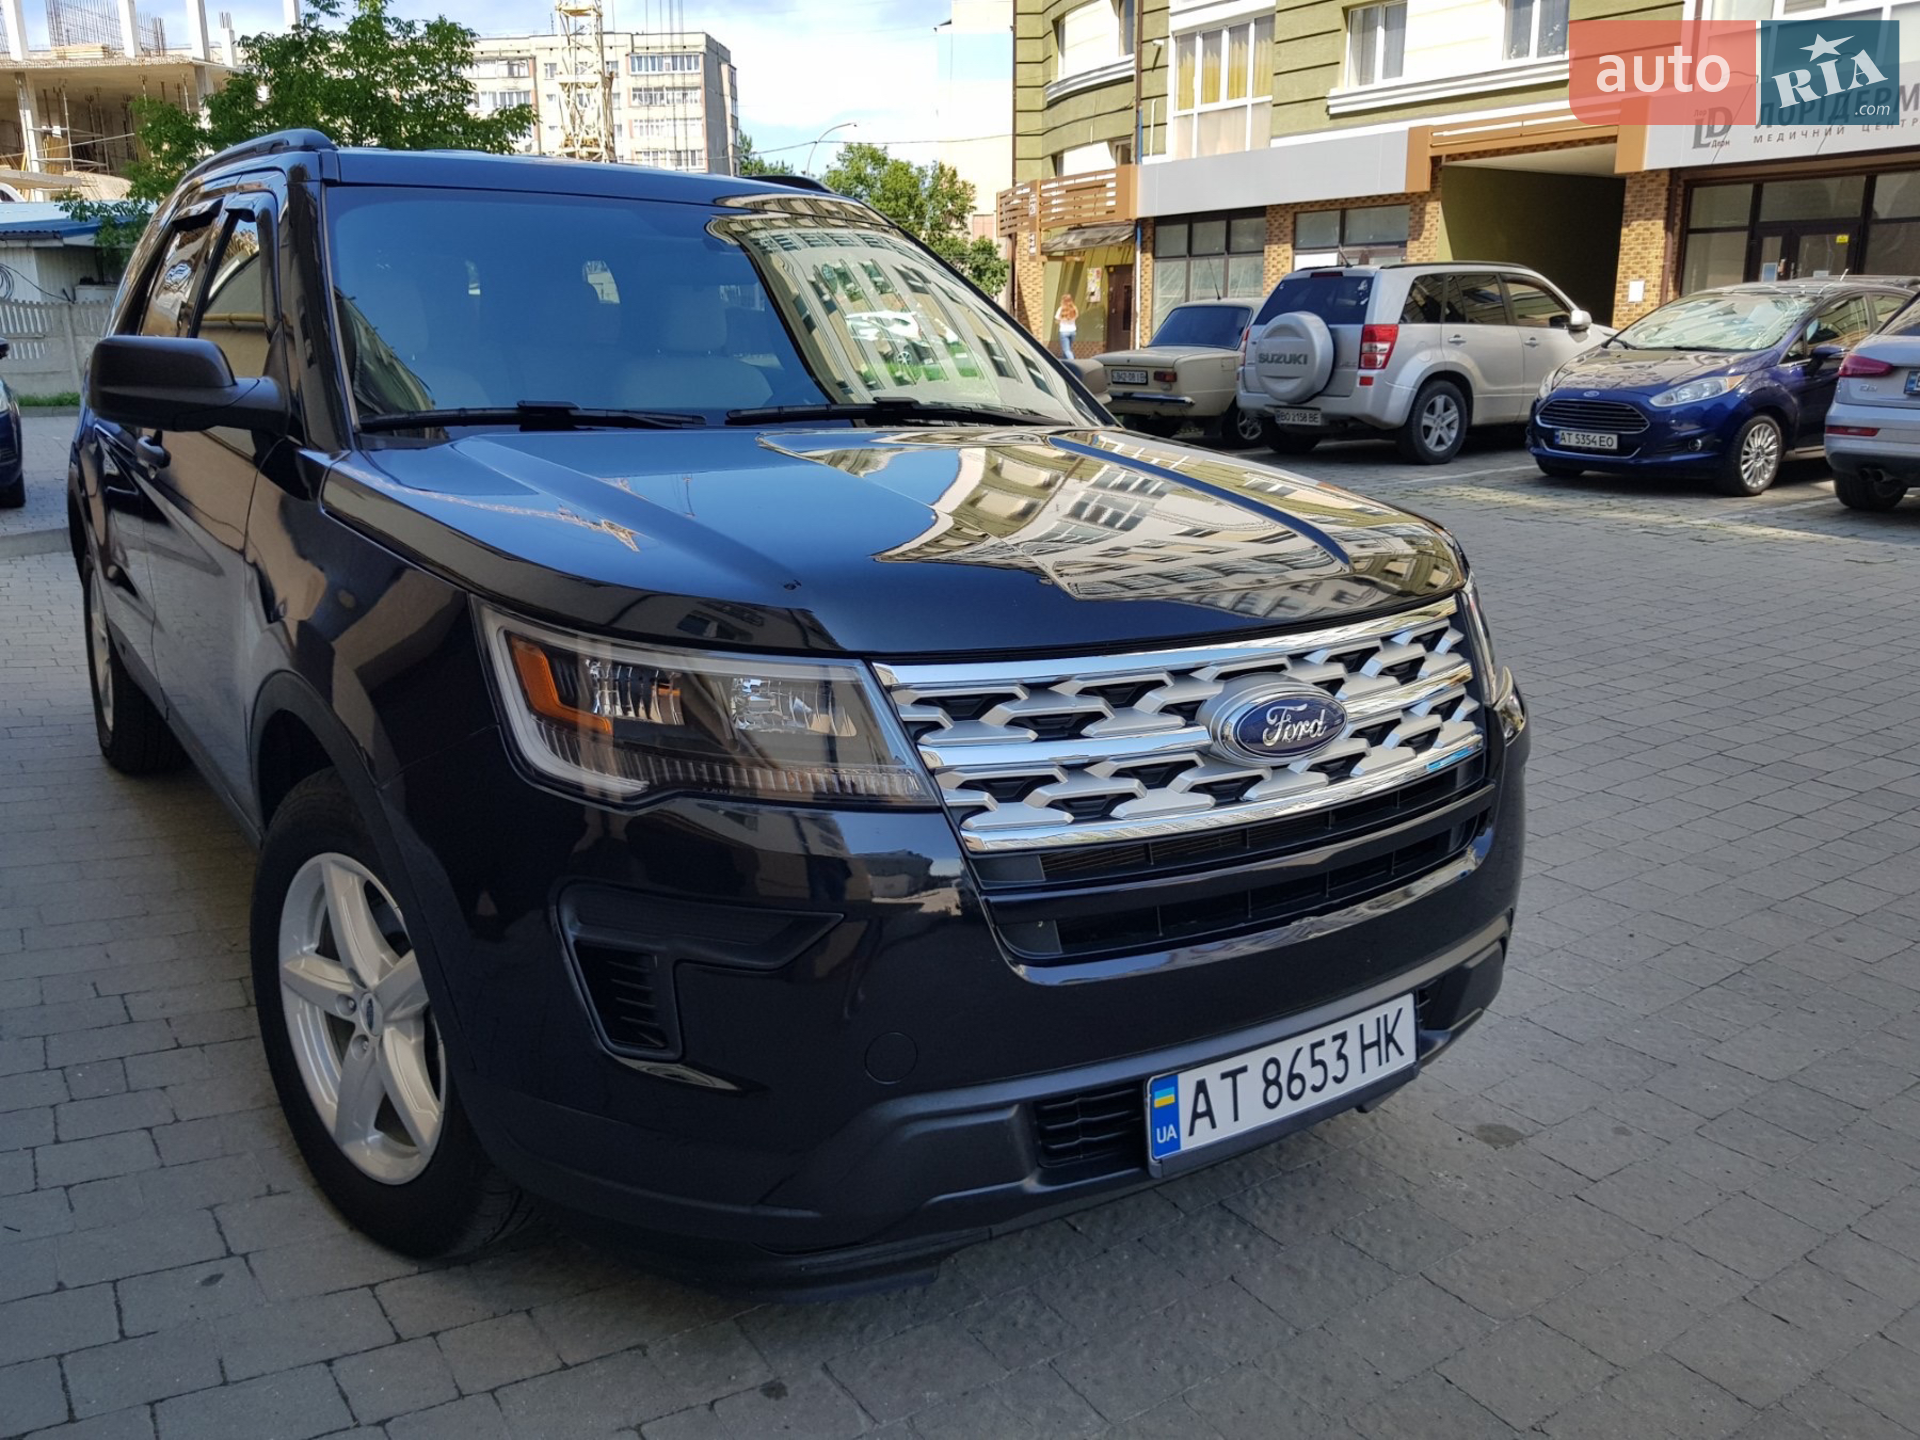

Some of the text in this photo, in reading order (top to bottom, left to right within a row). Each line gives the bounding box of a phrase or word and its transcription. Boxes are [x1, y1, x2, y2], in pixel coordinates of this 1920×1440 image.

[1862, 117, 1919, 133] ЦЕНТР
[1753, 125, 1846, 143] МЕДИЧНИЙ
[1258, 353, 1308, 365] SUZUKI
[1281, 412, 1291, 421] BO
[1292, 412, 1307, 422] 2158
[1560, 432, 1614, 447] AT 5354 EO
[1263, 703, 1327, 747] Ford
[1188, 1006, 1405, 1137] AT 8653 HK
[1156, 1123, 1178, 1144] UA
